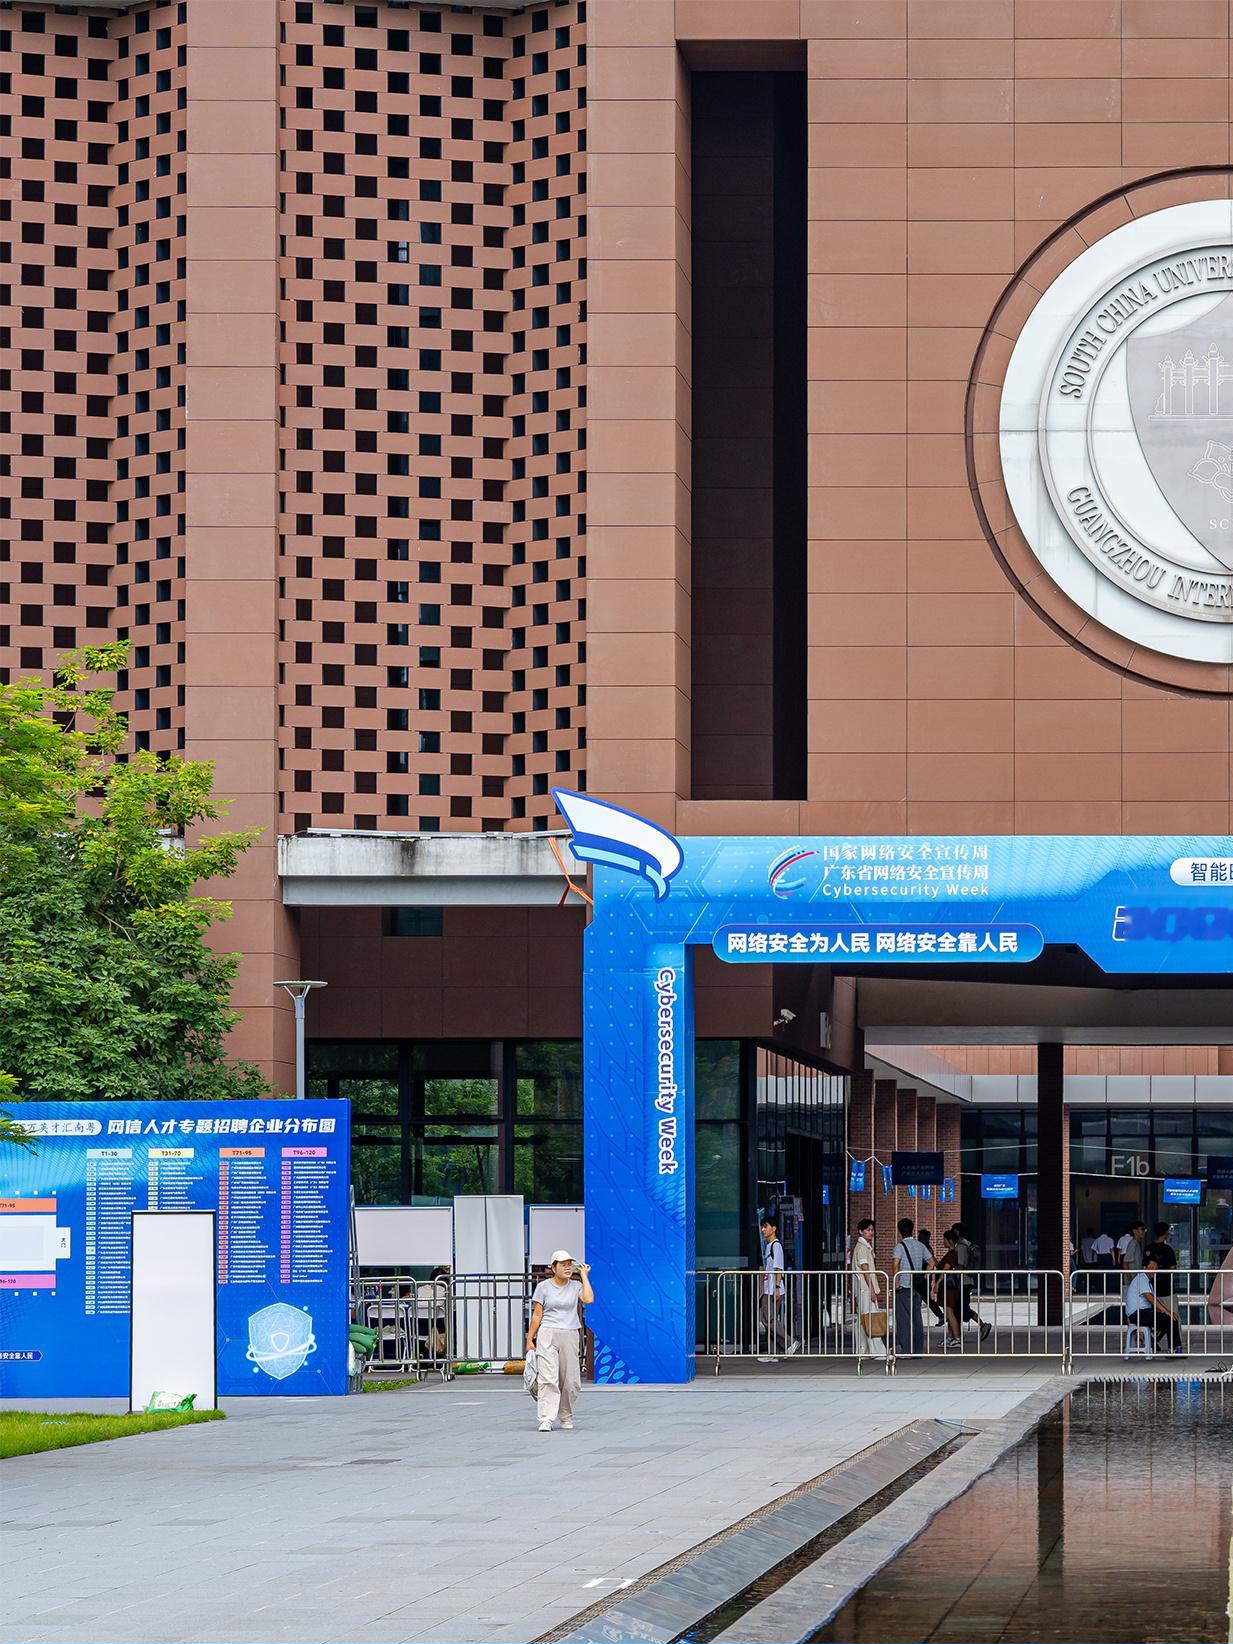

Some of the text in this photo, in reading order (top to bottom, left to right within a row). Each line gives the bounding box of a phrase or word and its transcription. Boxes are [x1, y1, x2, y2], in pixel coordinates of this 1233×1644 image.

[1059, 330, 1107, 399] SOUTH
[1096, 280, 1158, 333] CHINA
[1067, 484, 1168, 589] GUANGZHOU
[823, 845, 988, 861] 国家网络安全宣传周
[823, 864, 989, 881] 广东省网络安全宣传周
[822, 883, 989, 898] Cybersecurity Week
[727, 932, 1018, 953] 网络安全为人民 网络安全靠人民
[655, 967, 678, 1174] Cybersecurity Week
[22, 1122, 96, 1134] 万英才汇南粤
[108, 1119, 336, 1134] 网信人才专题招聘企业分布图
